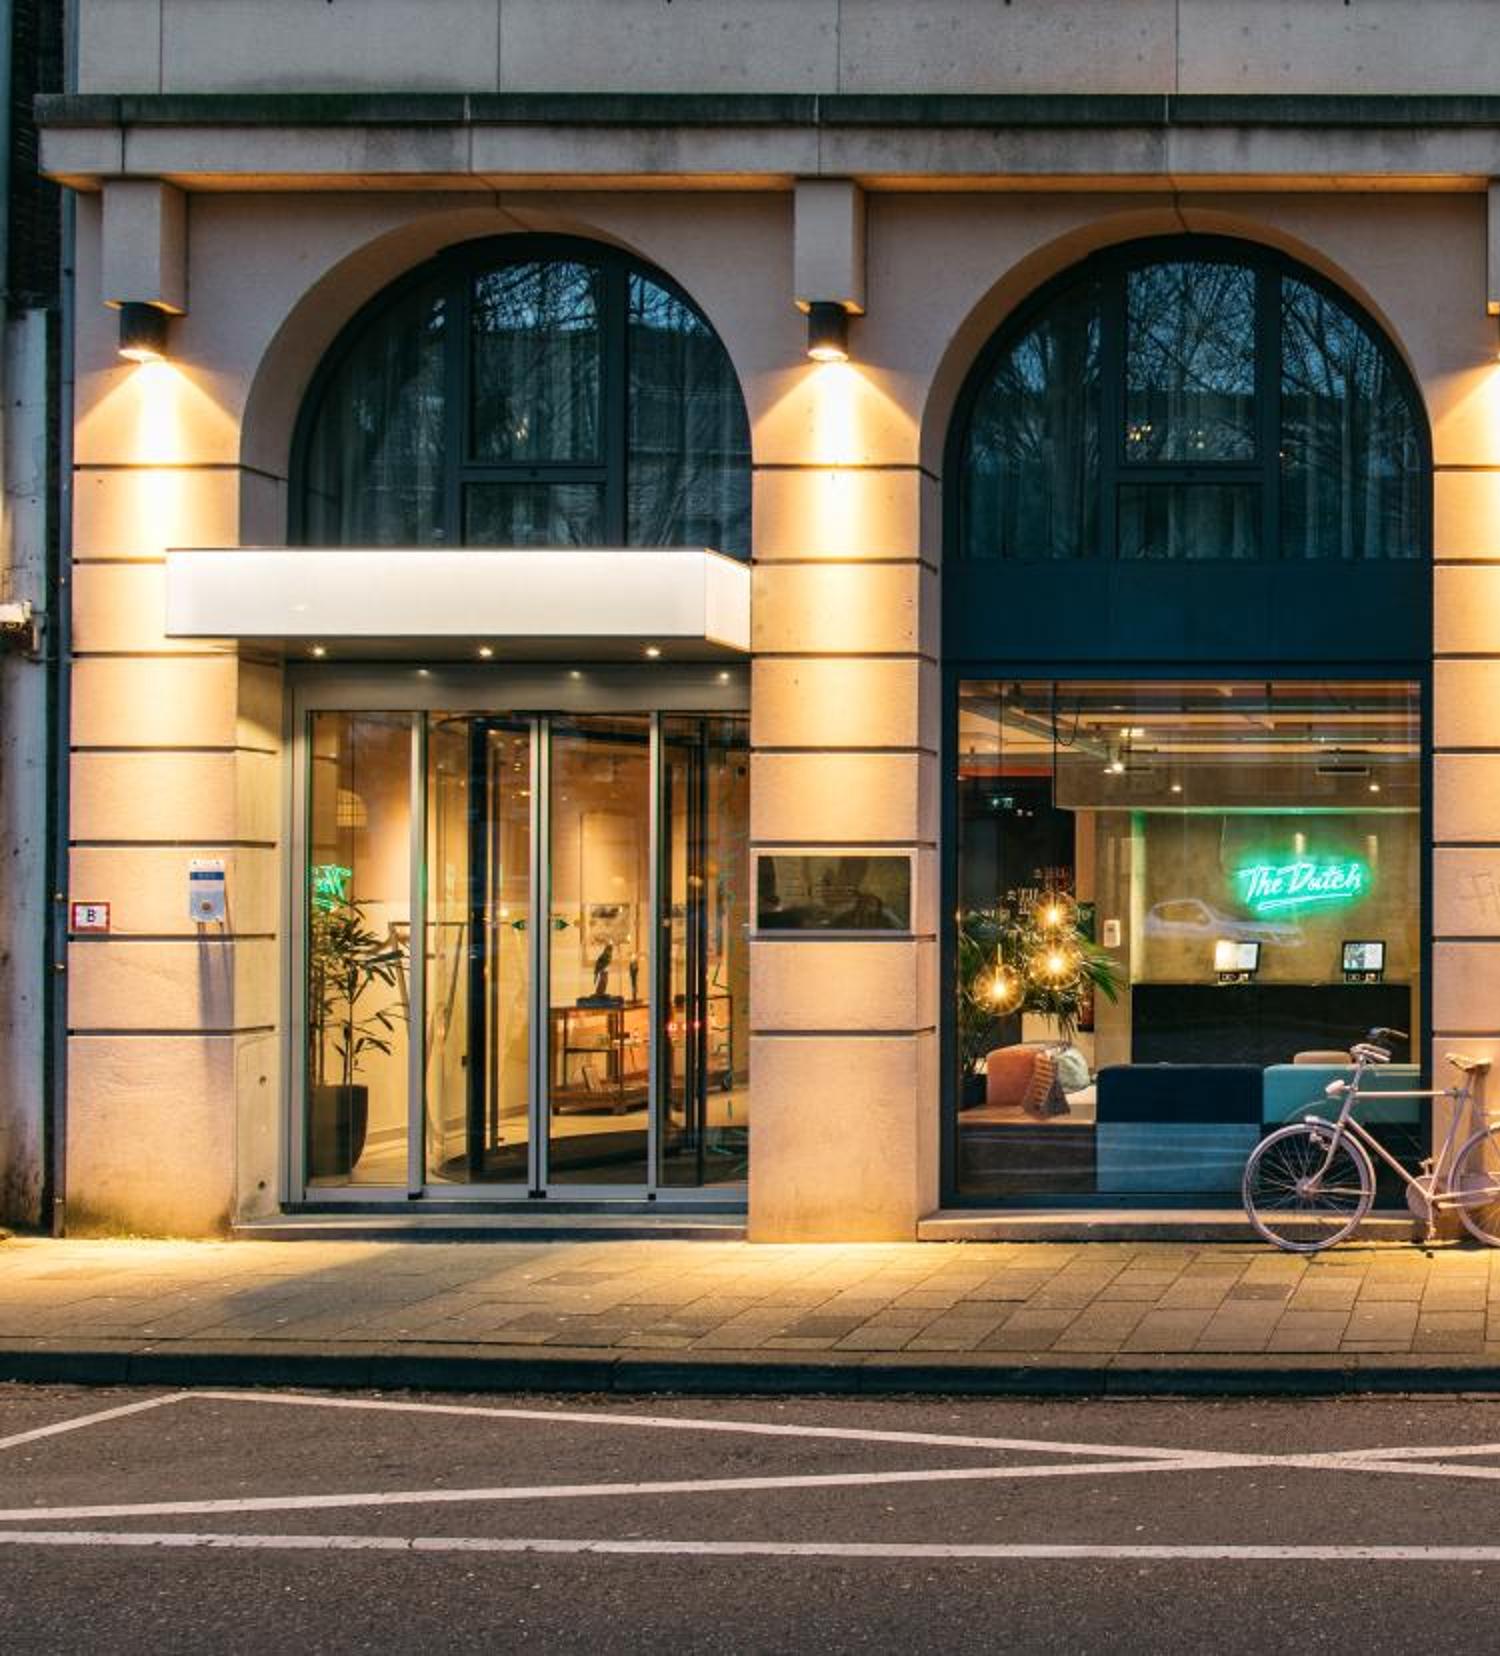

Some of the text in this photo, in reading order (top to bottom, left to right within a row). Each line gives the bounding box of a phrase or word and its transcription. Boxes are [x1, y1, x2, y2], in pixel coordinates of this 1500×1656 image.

[1238, 863, 1361, 902] The Dutch
[87, 909, 97, 922] B
